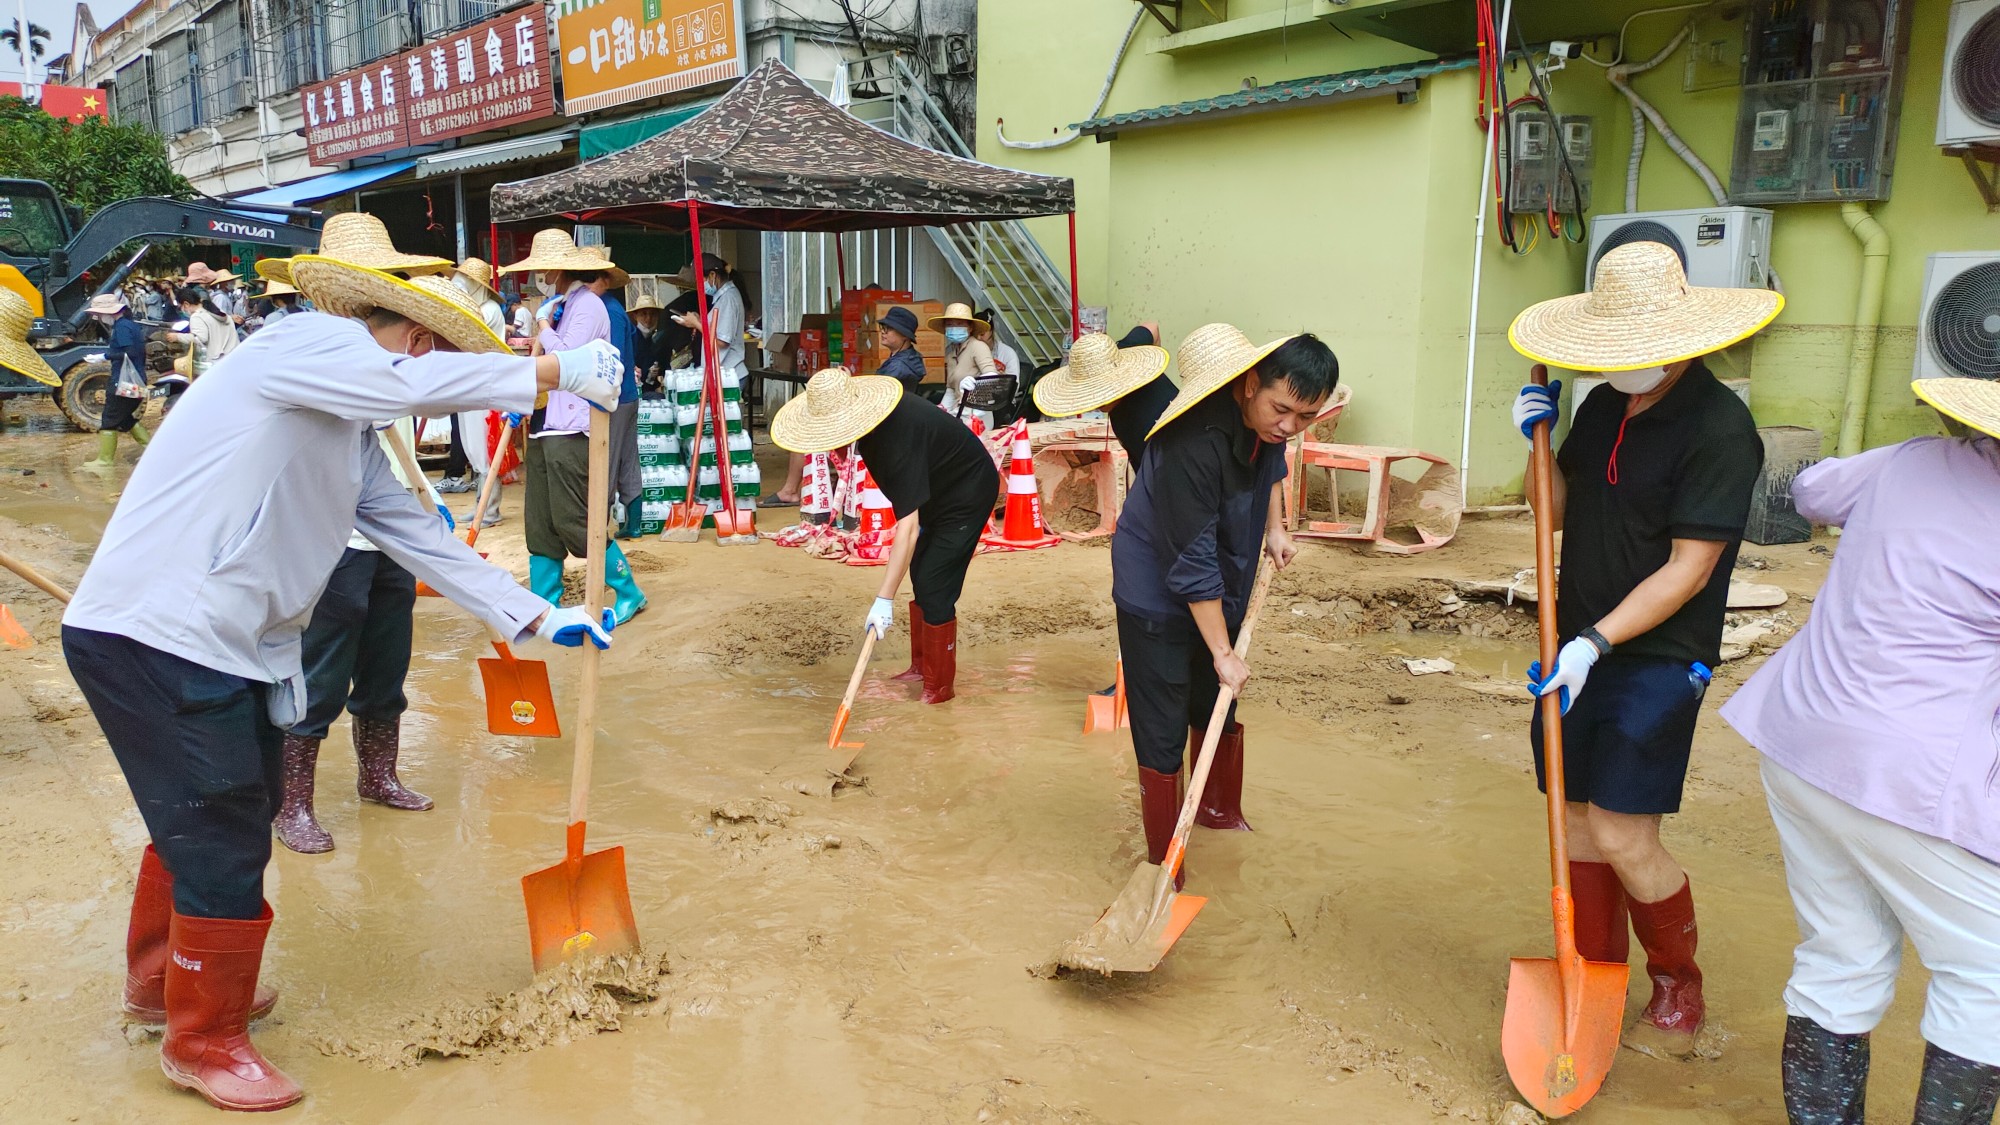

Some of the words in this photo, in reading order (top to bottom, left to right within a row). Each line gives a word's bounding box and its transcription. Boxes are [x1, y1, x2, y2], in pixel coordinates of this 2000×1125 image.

[408, 15, 536, 98] 海涛副食店
[815, 453, 830, 510] 保亭交通
[1031, 497, 1041, 529] 保亭交通
